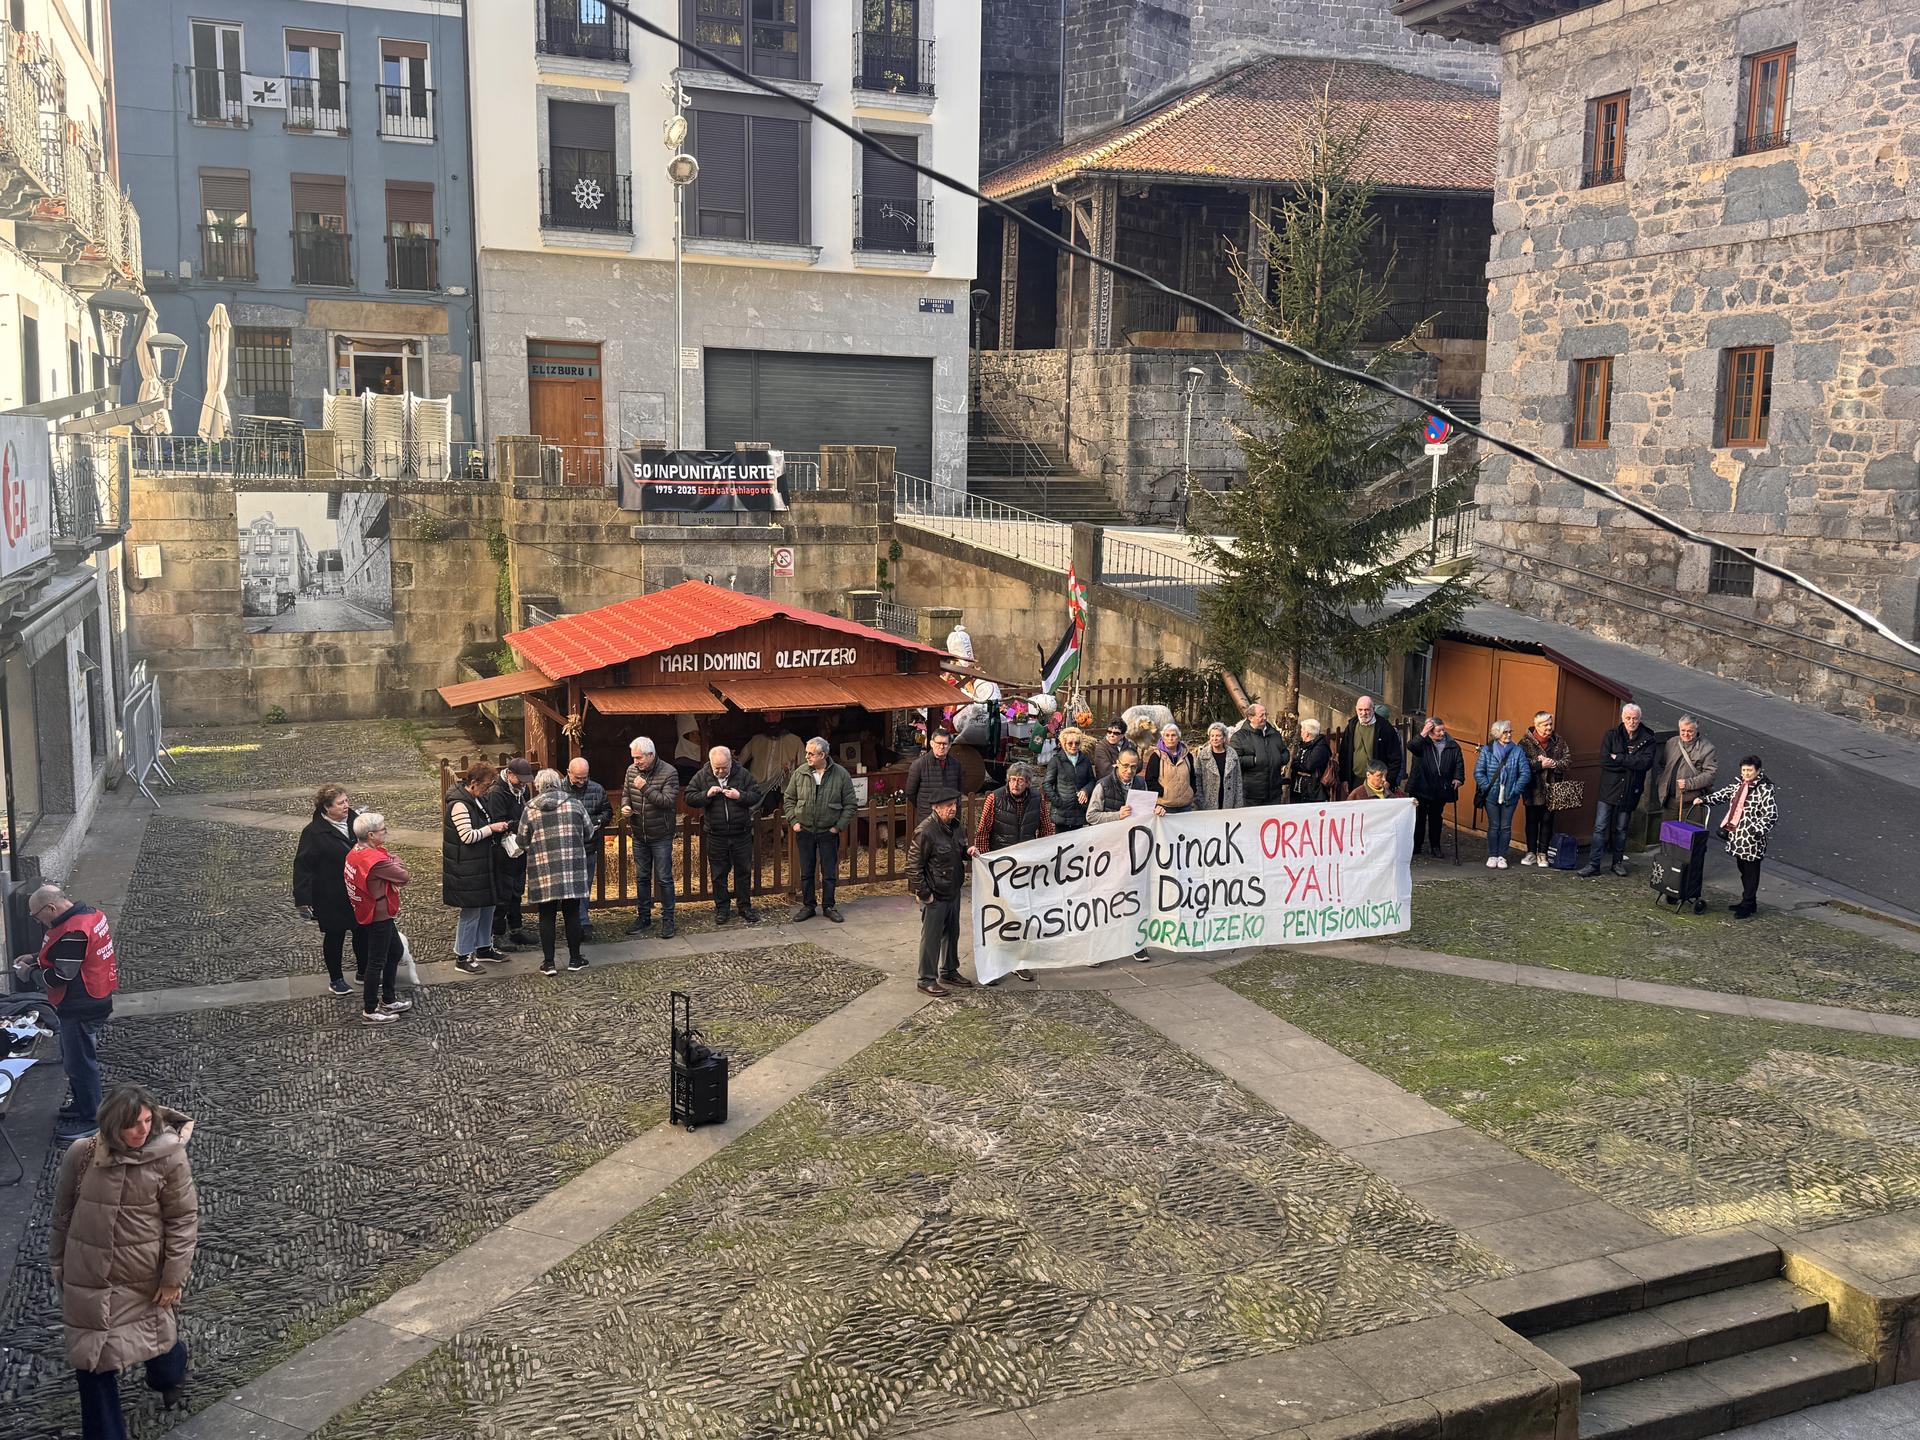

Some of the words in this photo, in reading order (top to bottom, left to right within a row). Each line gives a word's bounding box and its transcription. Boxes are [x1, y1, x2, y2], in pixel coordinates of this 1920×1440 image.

[532, 365, 584, 376] ELIZBURU
[634, 463, 651, 479] 50
[654, 464, 736, 480] INPUNITATE
[739, 465, 776, 480] URTE
[655, 485, 673, 495] 1975
[677, 485, 697, 495] 2025
[660, 653, 698, 672] MARI
[703, 651, 761, 671] DOMINGI
[775, 647, 857, 668] OLENTZERO
[988, 843, 1111, 897] Pentsio
[981, 890, 1141, 947] Pensiones
[1158, 875, 1267, 919] Dignas
[1283, 863, 1342, 905] YA!!
[1135, 912, 1265, 948] SORALUZEKO
